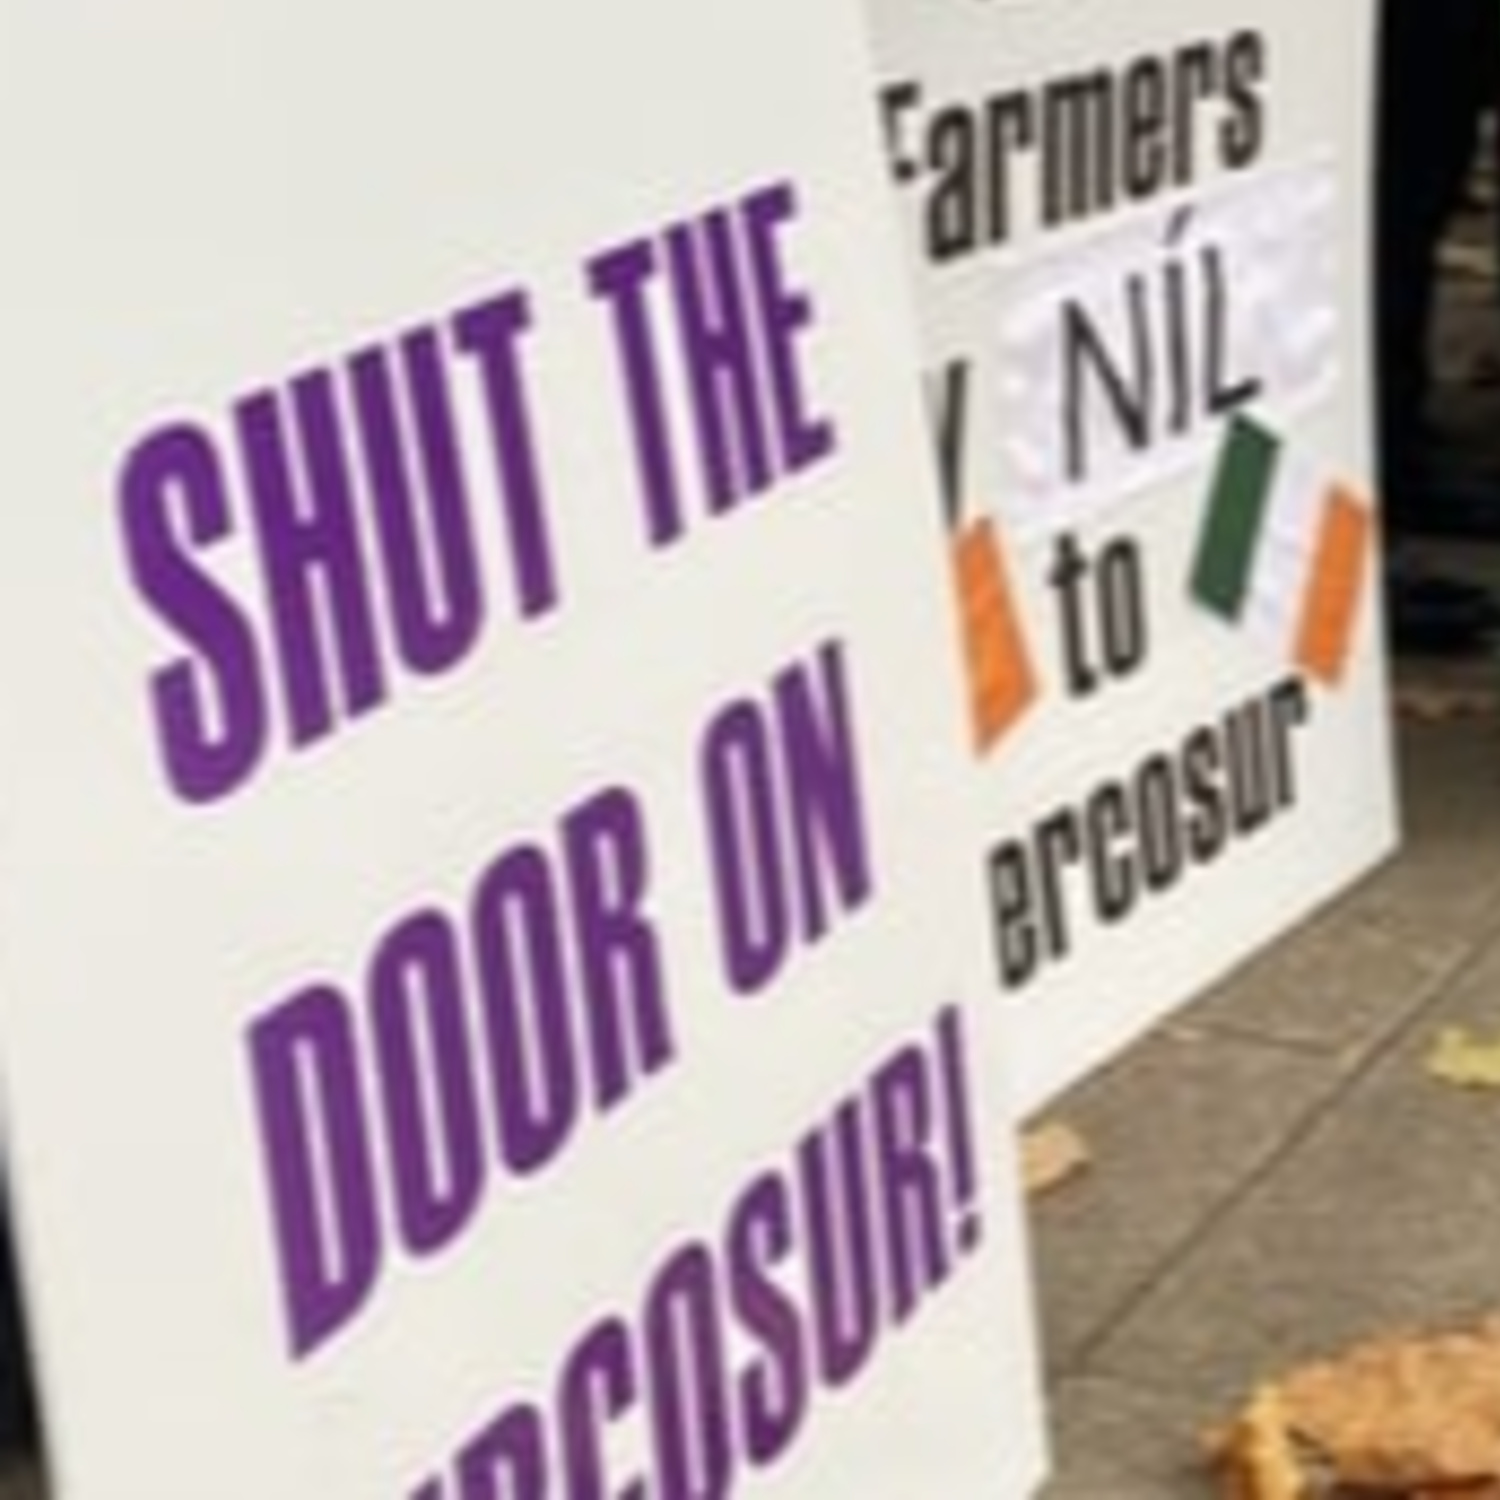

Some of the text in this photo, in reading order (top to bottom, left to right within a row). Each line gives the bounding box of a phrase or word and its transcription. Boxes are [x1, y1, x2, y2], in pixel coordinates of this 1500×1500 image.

[115, 286, 560, 806] SHUT
[585, 180, 837, 550] THE
[1063, 204, 1263, 483] NÍL
[1046, 532, 1147, 697] to
[987, 673, 1310, 991] ercosur
[243, 637, 873, 1363] DOOR ON
